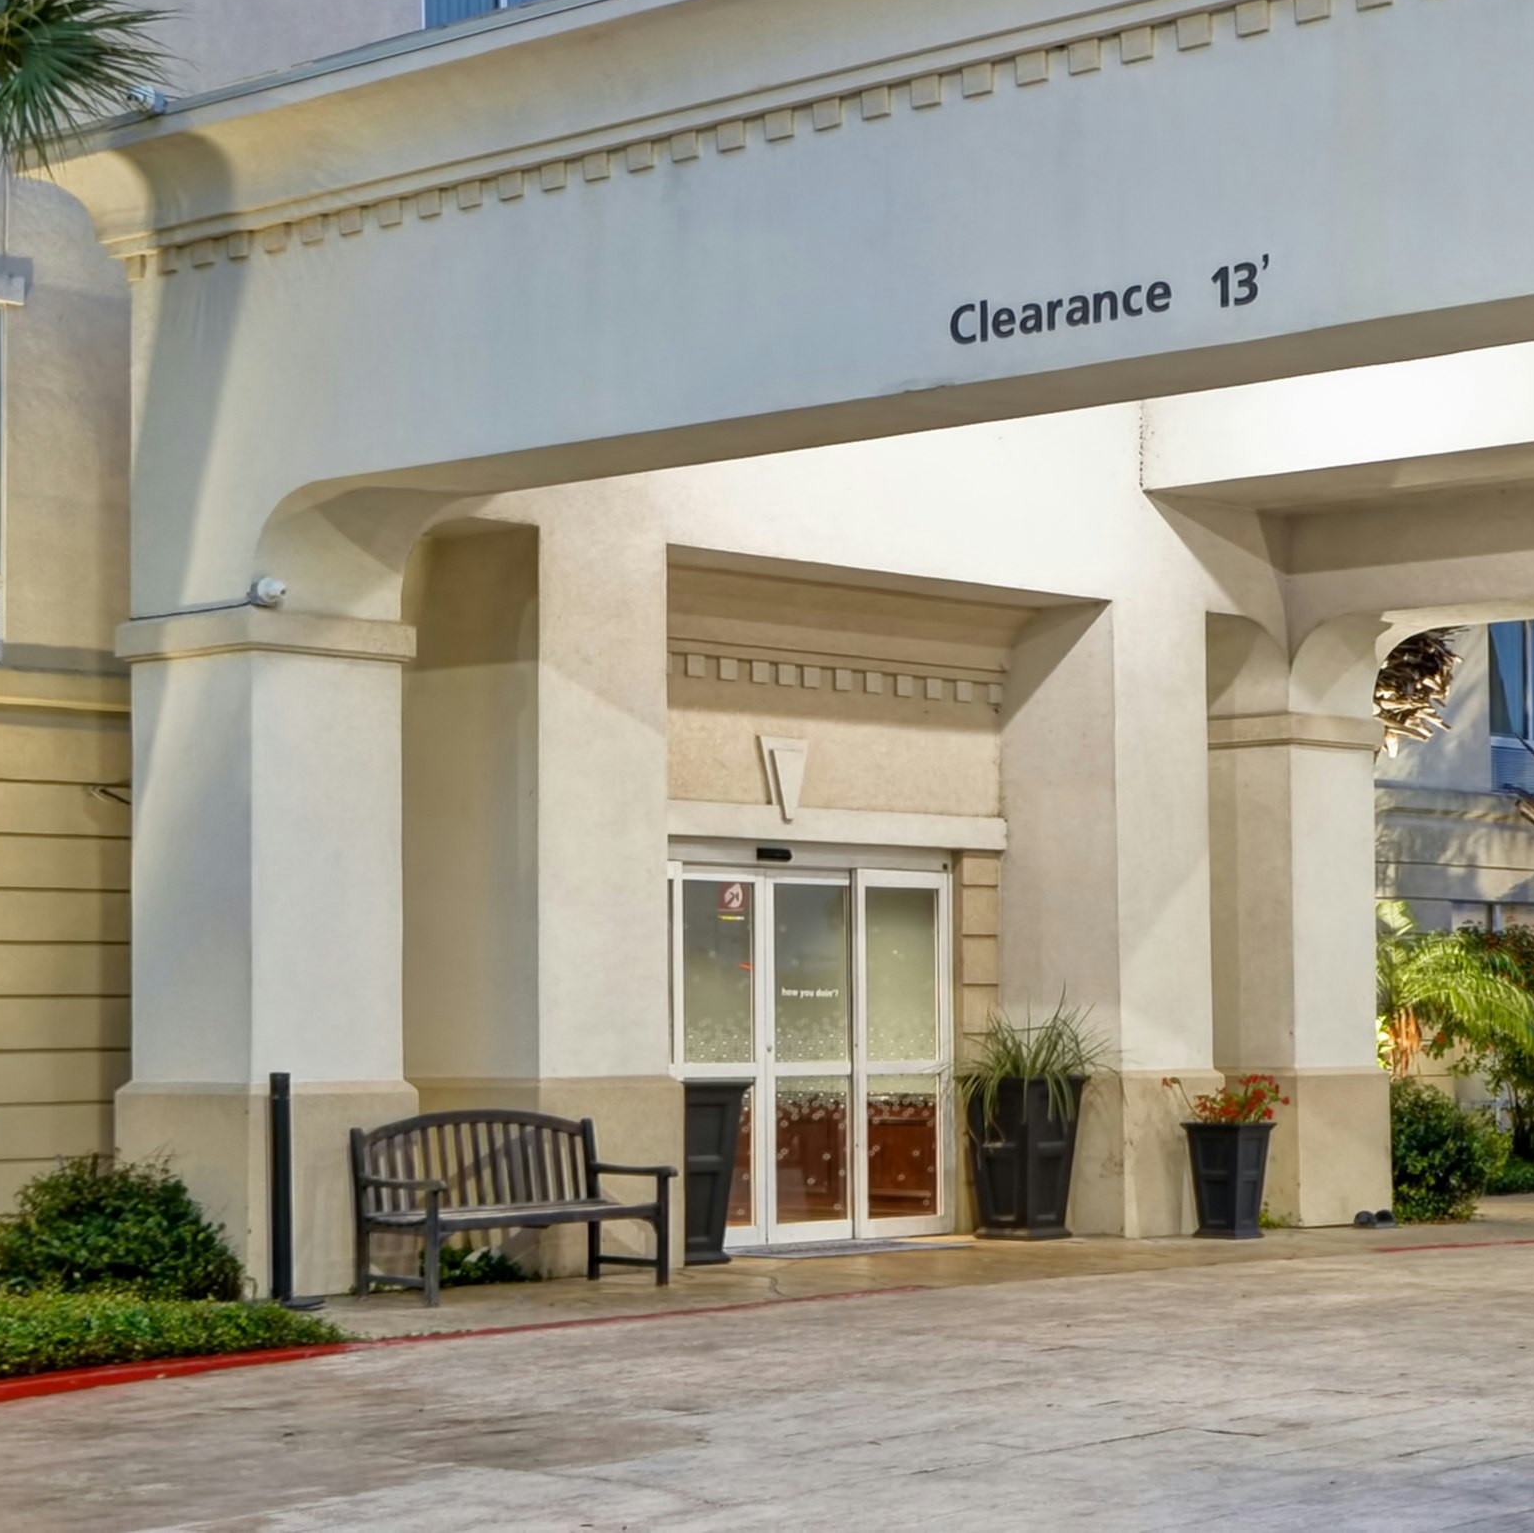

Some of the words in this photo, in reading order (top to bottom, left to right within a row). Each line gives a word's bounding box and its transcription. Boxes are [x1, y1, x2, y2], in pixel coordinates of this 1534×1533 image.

[949, 279, 1173, 345] Clearance
[781, 986, 799, 997] how
[800, 989, 814, 999] you
